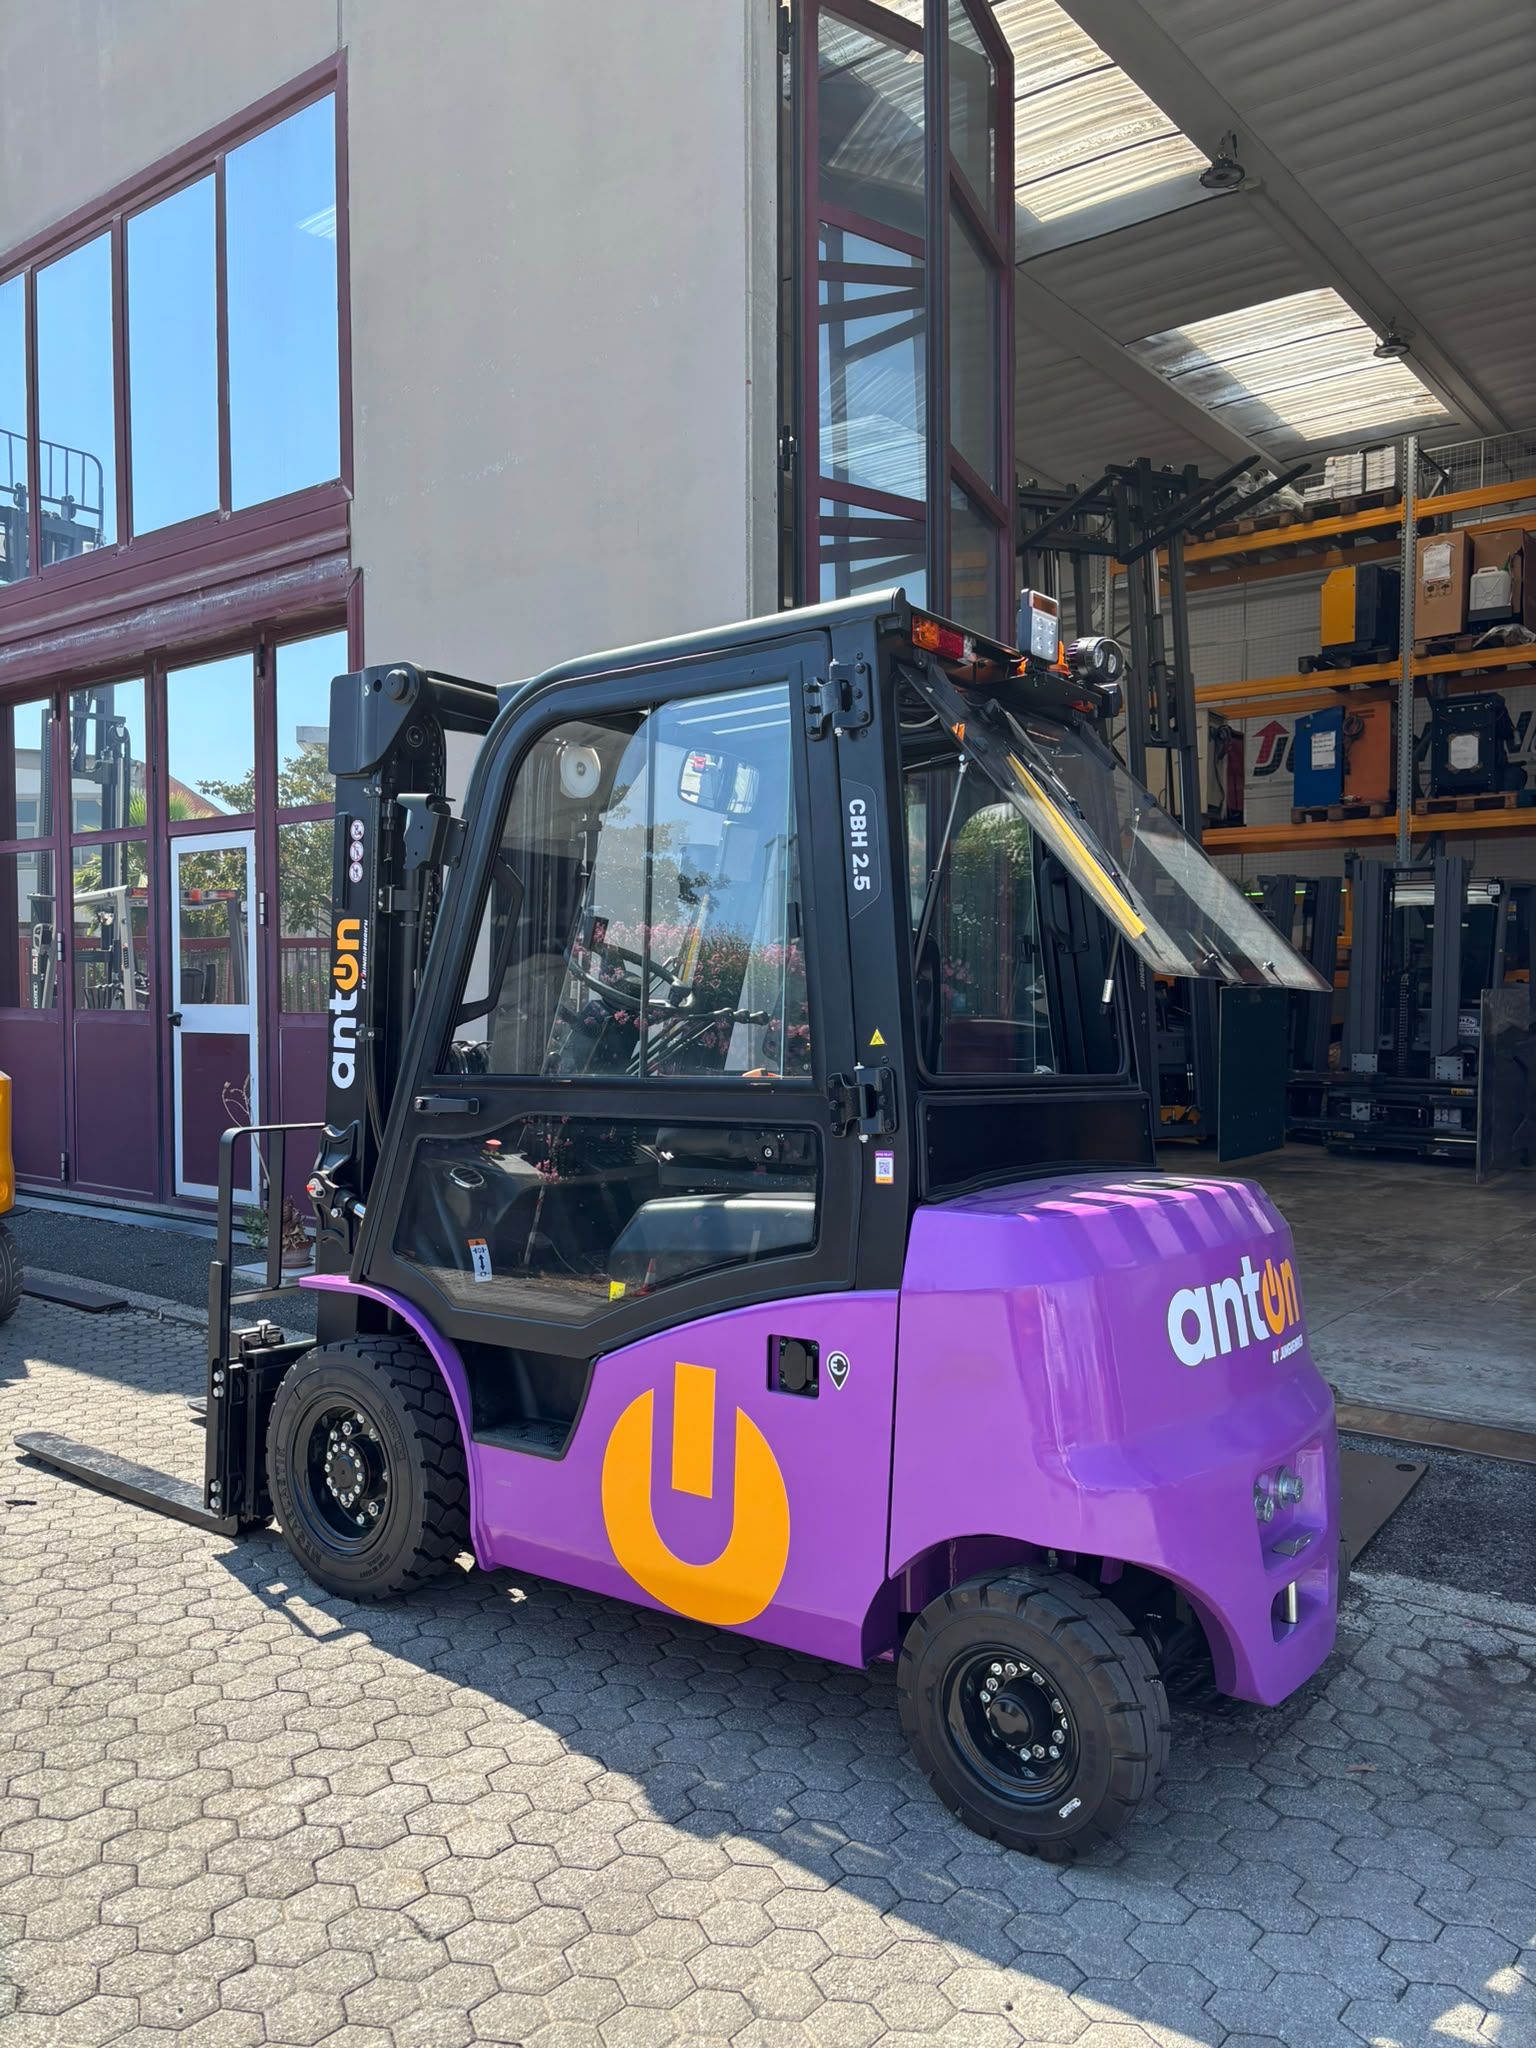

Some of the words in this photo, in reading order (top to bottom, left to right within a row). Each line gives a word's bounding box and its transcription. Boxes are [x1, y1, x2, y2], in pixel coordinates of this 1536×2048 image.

[849, 799, 868, 847] CBH
[852, 854, 870, 891] 2.5
[329, 919, 360, 1090] anton
[1167, 1255, 1301, 1367] anton
